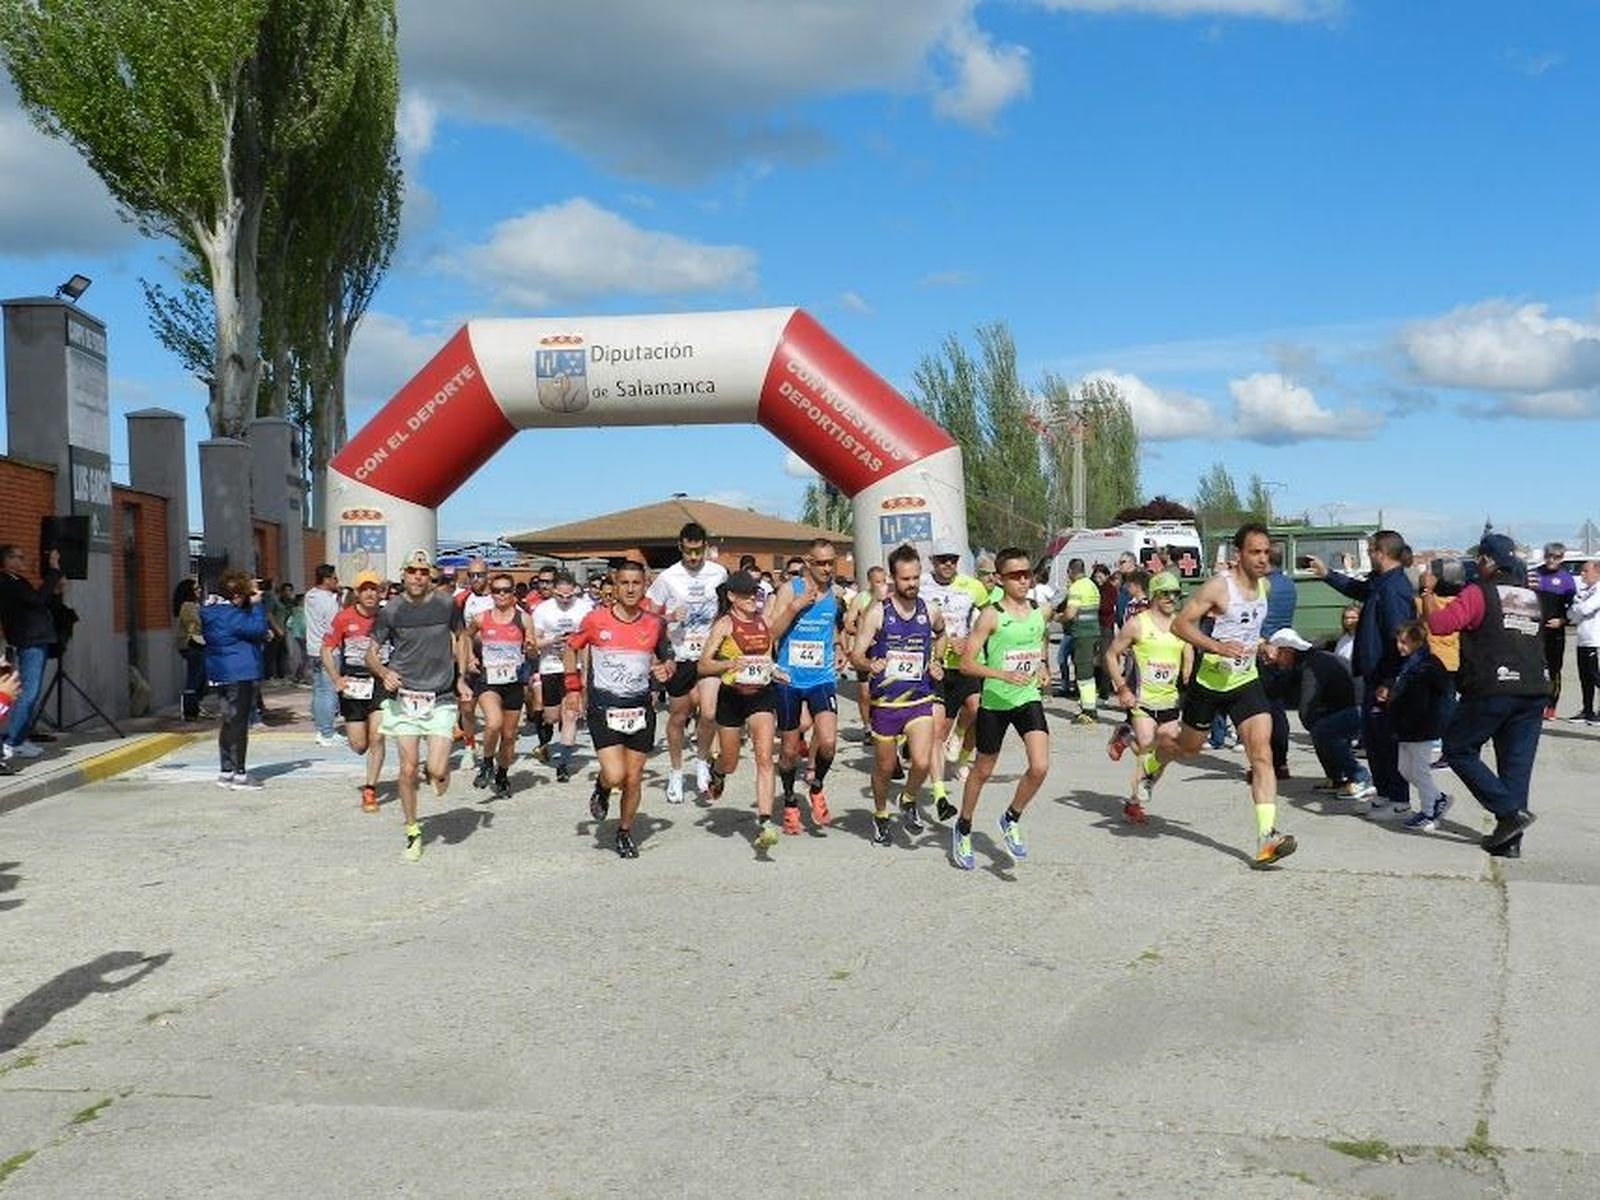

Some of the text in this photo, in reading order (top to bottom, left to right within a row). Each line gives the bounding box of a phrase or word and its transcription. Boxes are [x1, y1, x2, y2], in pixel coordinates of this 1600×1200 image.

[590, 340, 694, 366] Diputación
[591, 378, 716, 399] de Salamanca
[354, 363, 476, 480] CON EL DEPORTE
[778, 381, 884, 472] DEPORTISTAS
[898, 662, 914, 673] 62
